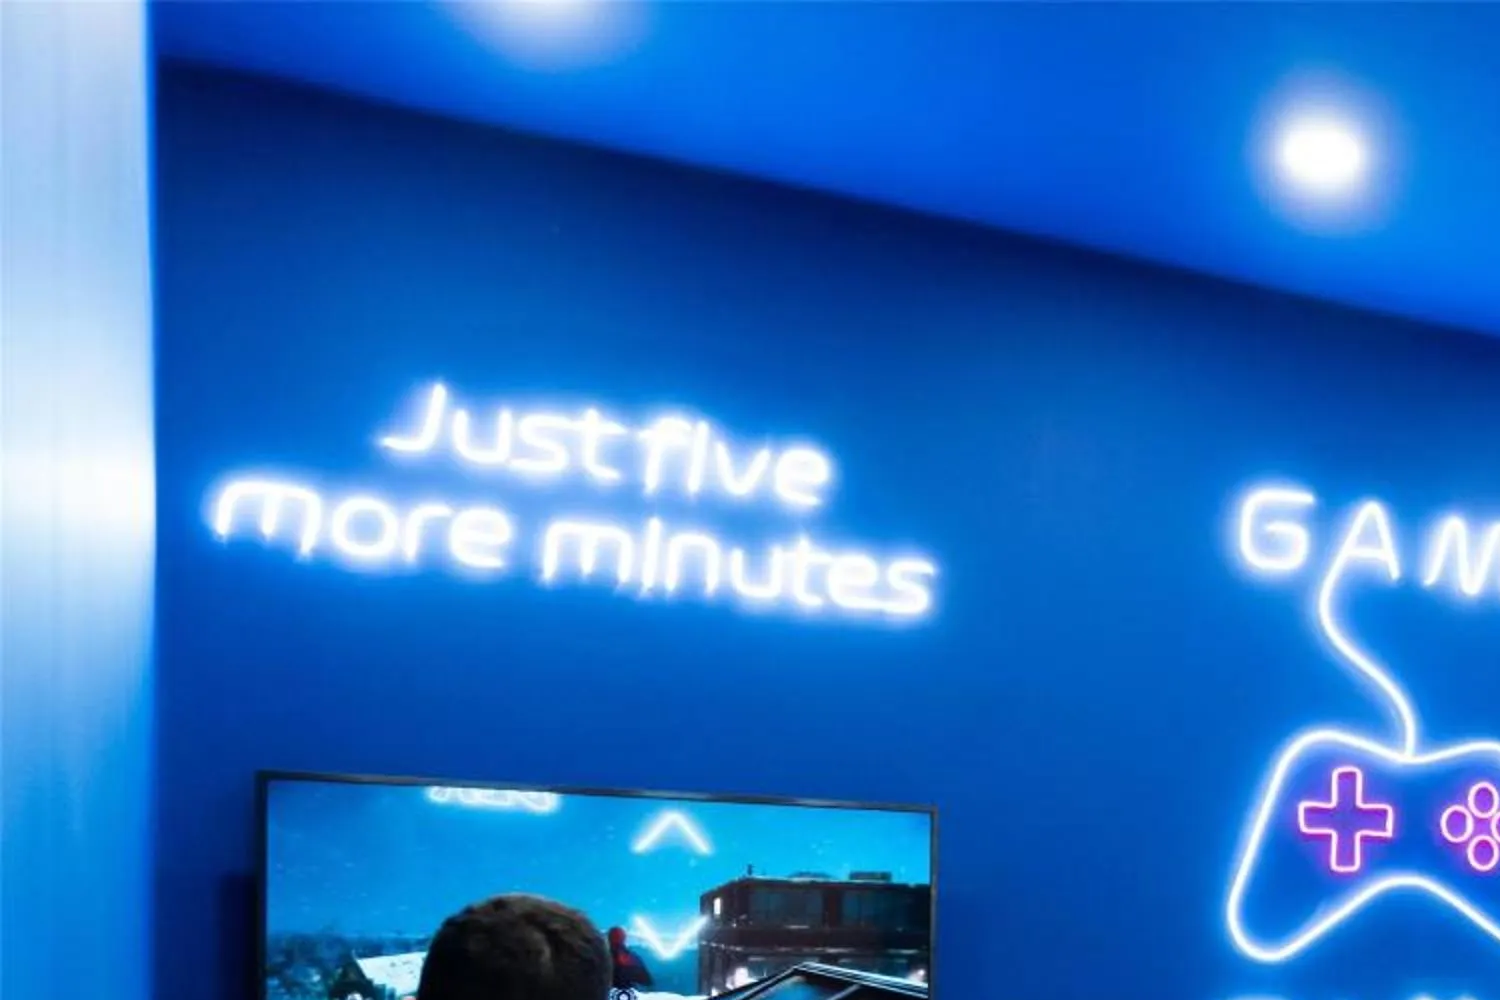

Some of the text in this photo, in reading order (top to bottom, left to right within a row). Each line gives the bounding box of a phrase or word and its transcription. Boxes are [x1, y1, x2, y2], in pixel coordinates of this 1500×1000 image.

[377, 381, 834, 507] Just five
[212, 476, 938, 615] more minutes
